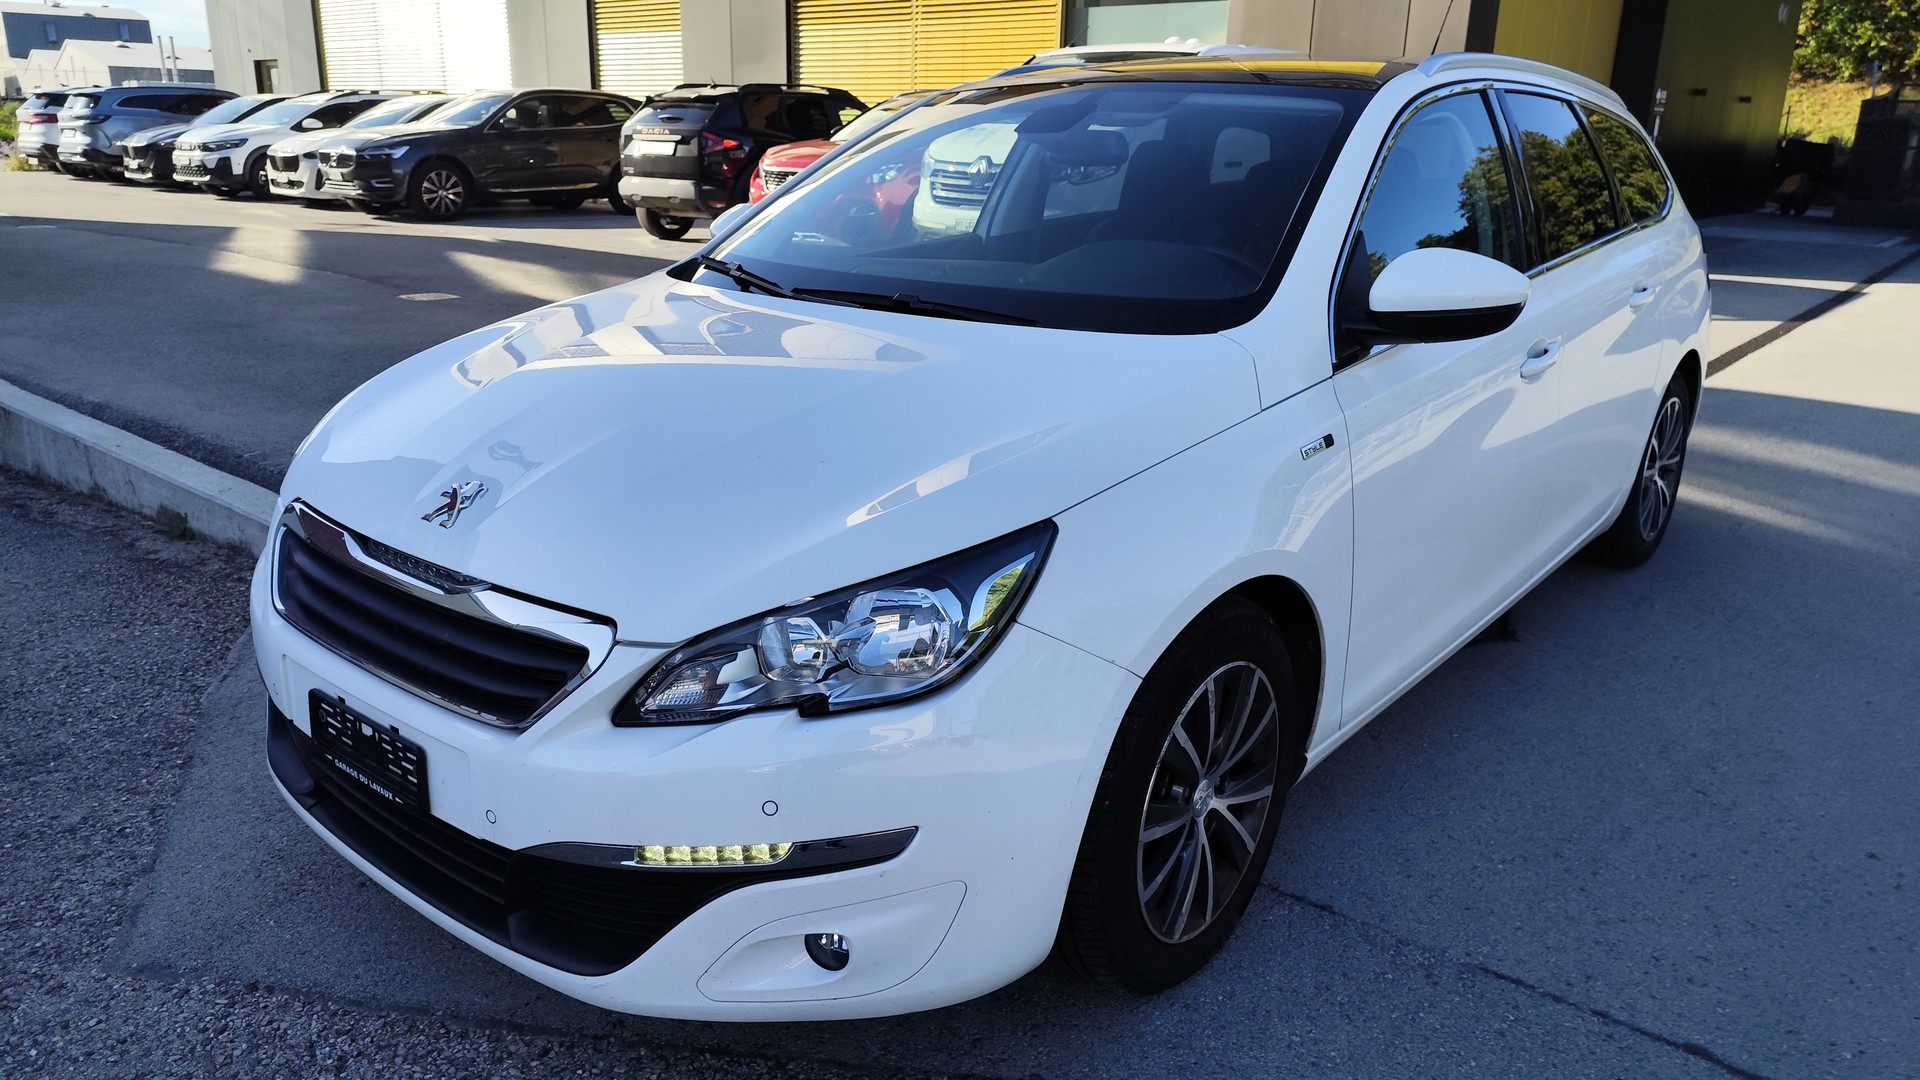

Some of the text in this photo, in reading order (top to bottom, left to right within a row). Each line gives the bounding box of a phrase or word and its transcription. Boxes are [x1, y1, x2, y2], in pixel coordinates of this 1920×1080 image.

[1304, 441, 1324, 457] STYLE
[335, 759, 394, 801] GARAGE DU LAVAUX
